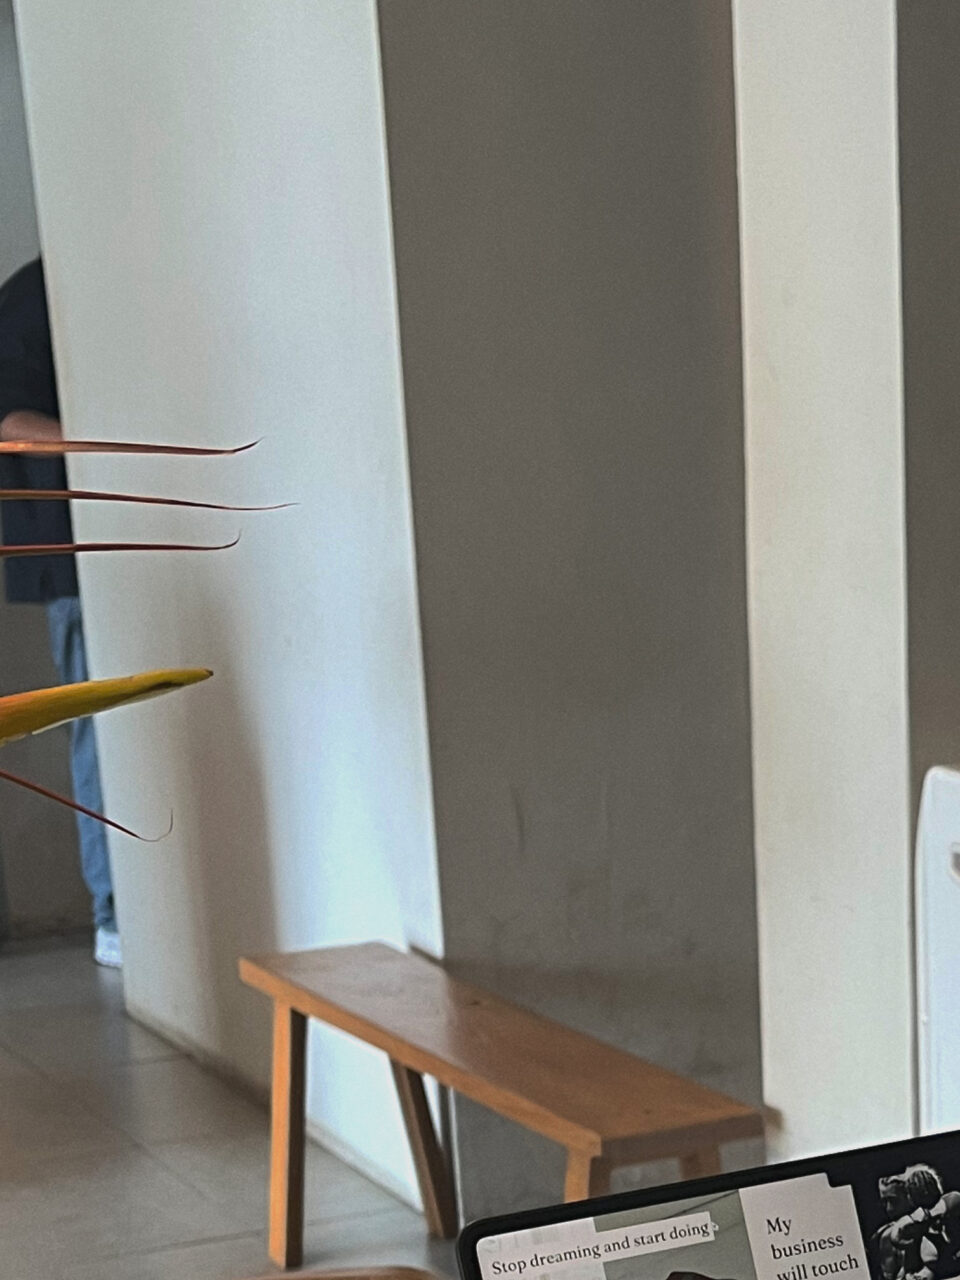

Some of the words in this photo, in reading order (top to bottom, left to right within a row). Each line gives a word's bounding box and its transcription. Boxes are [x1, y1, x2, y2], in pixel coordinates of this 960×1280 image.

[766, 1217, 792, 1236] My
[492, 1257, 527, 1275] Stop
[530, 1244, 602, 1268] dreaming
[604, 1236, 631, 1253] and
[633, 1232, 666, 1247] start
[669, 1222, 711, 1240] doing
[770, 1235, 844, 1260] business
[812, 1254, 859, 1277] touch
